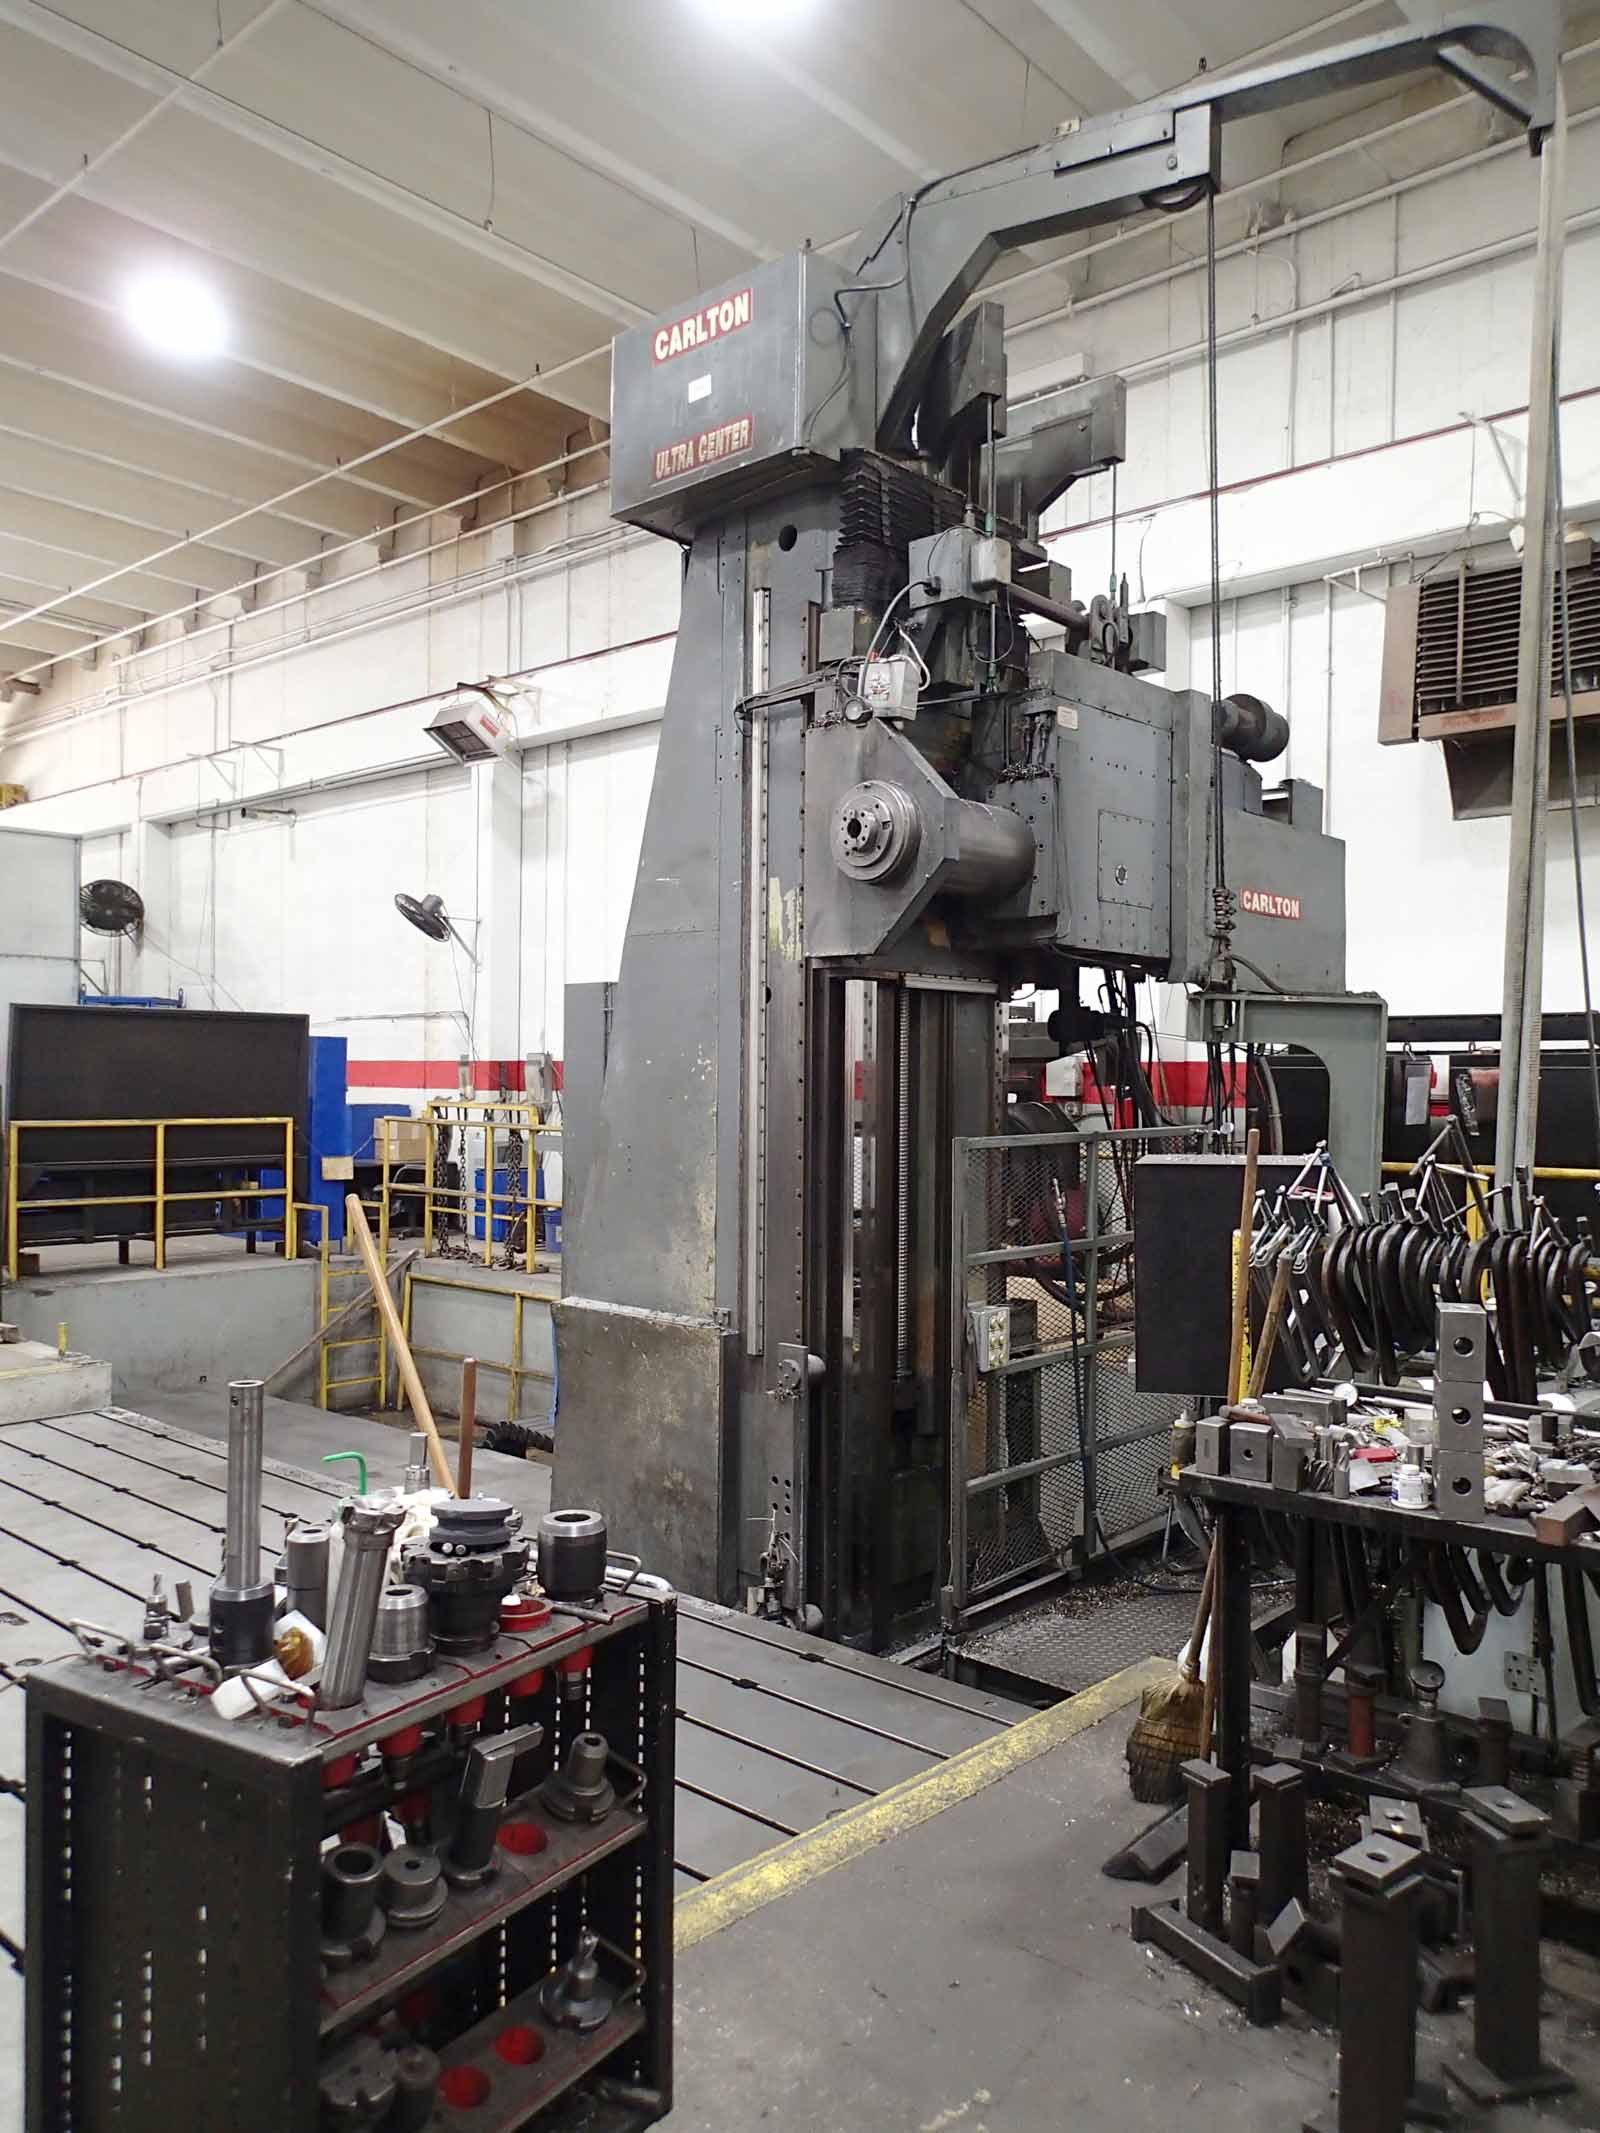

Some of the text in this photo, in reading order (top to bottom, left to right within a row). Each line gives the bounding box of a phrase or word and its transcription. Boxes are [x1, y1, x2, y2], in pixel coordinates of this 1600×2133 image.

[654, 292, 750, 361] CARLTON
[655, 419, 750, 479] ULTRA CENTER
[1242, 890, 1301, 919] CARLTON
